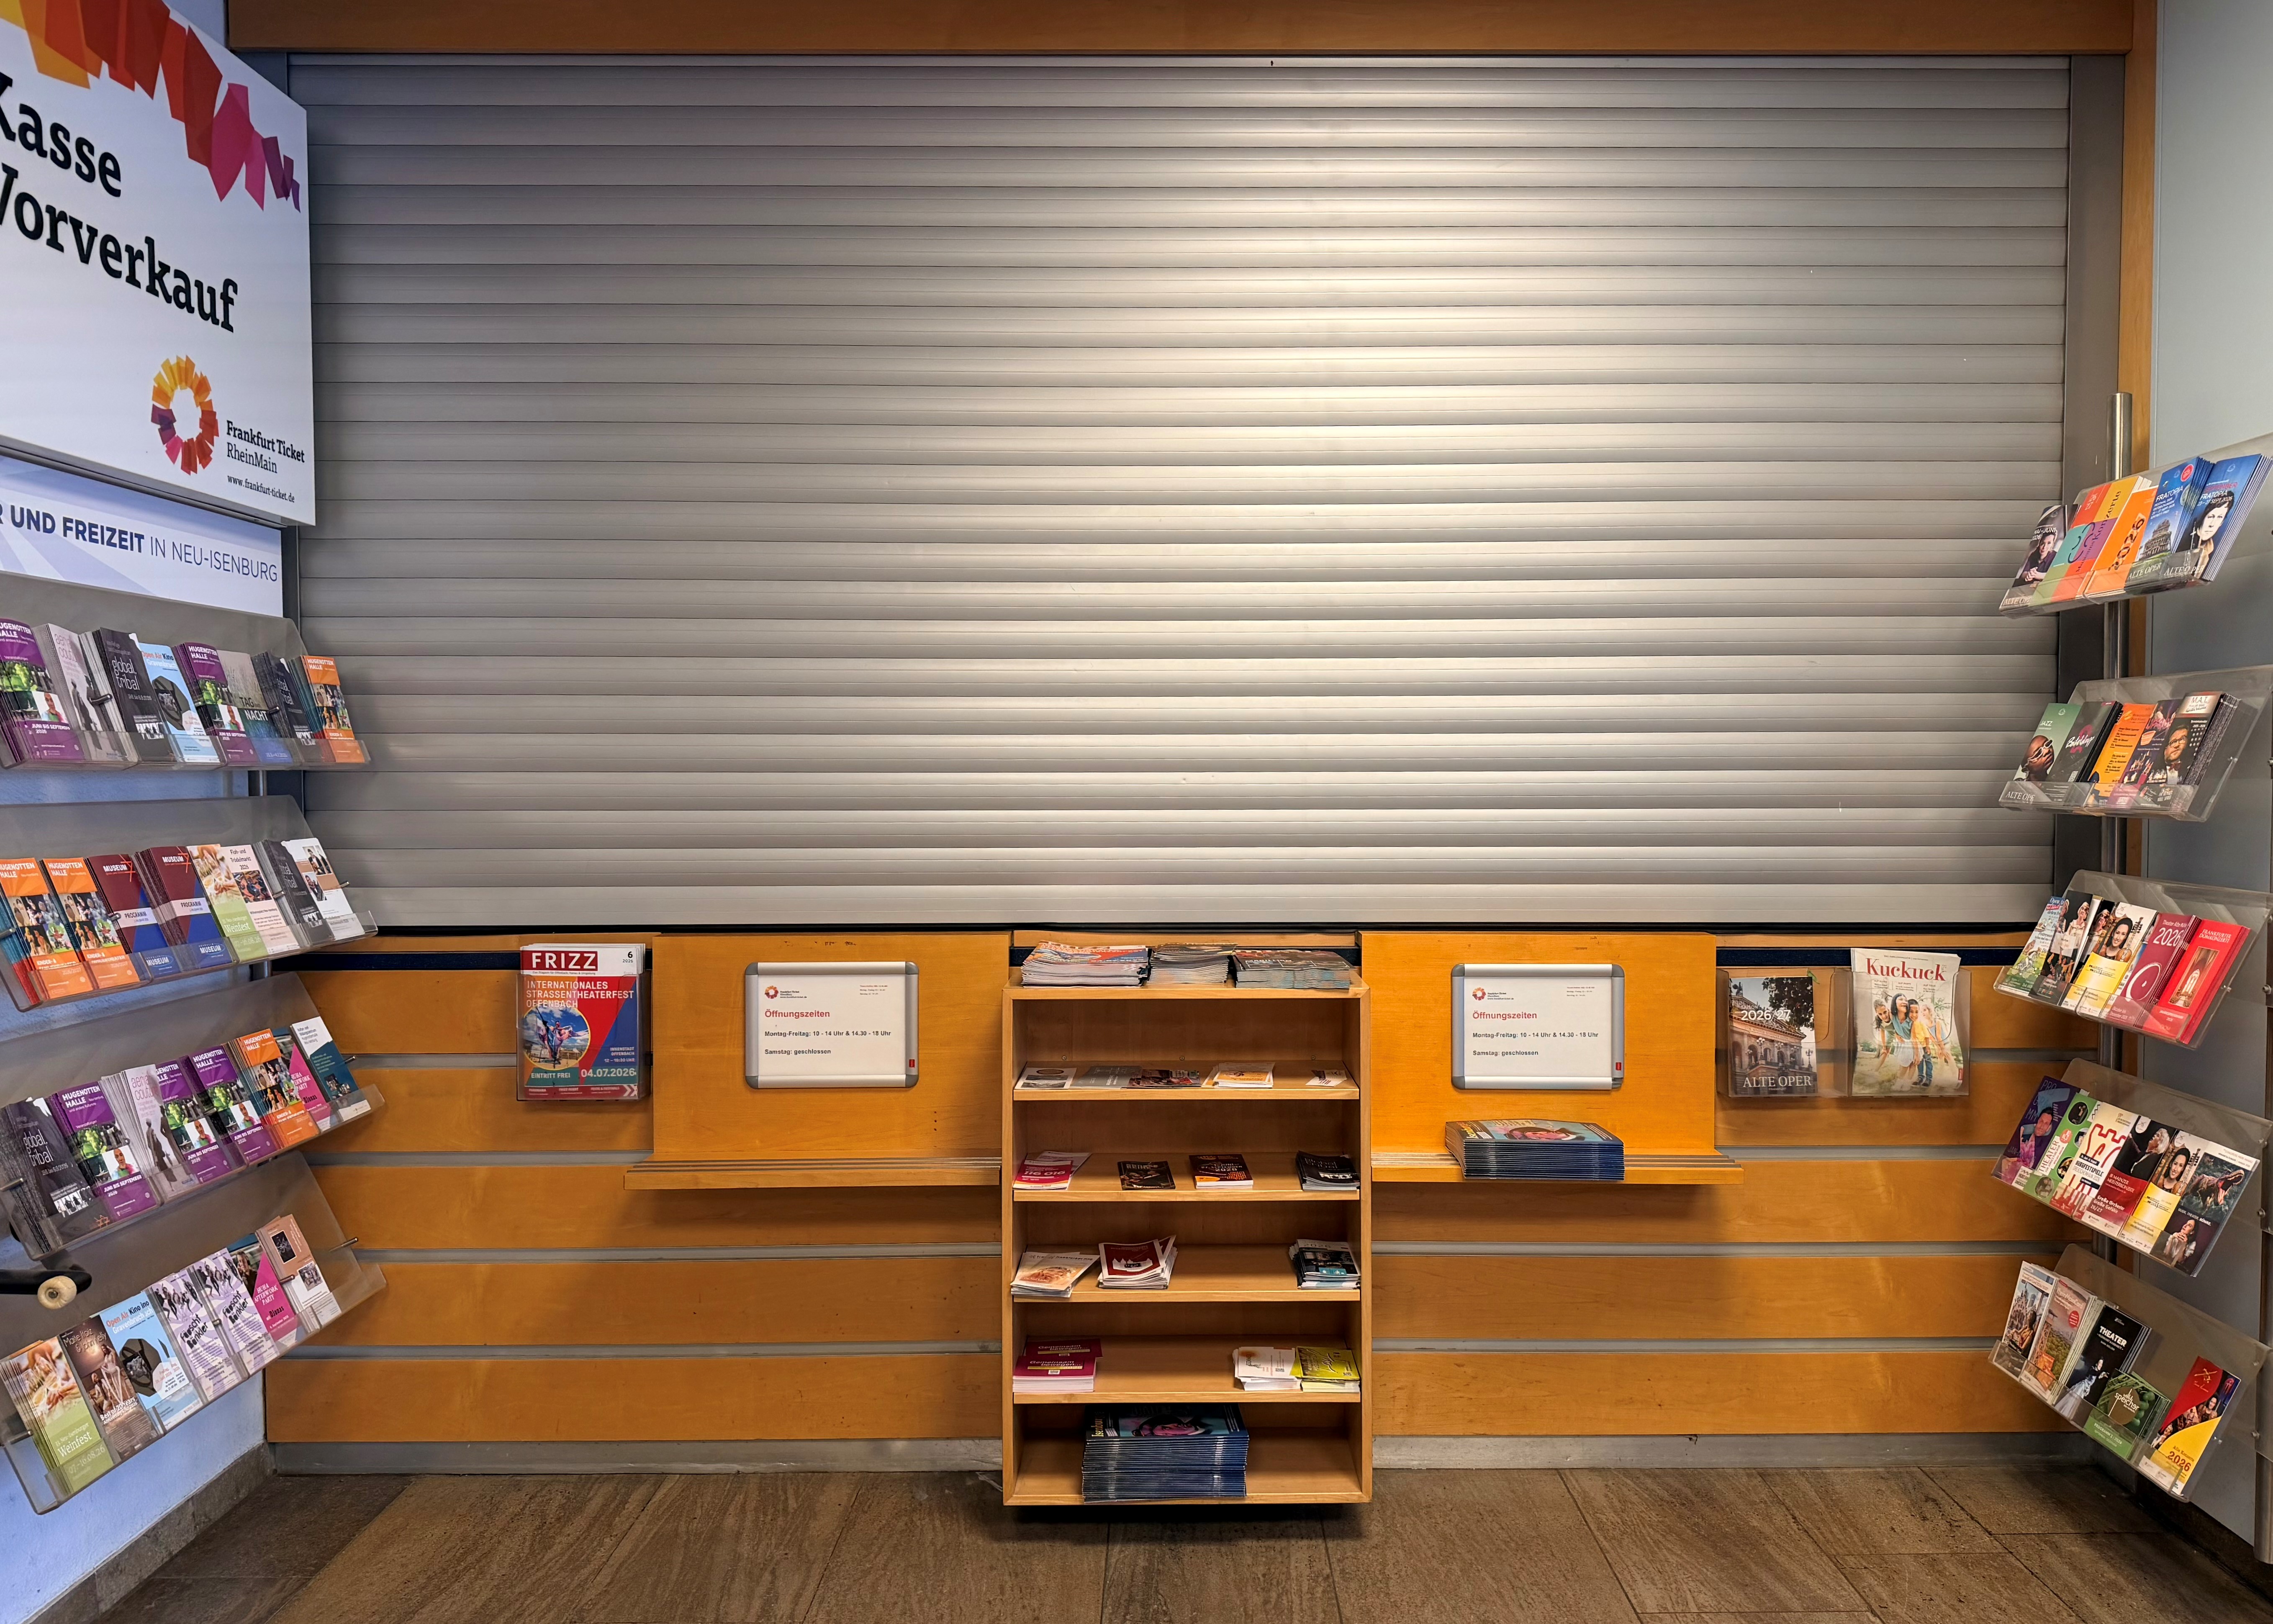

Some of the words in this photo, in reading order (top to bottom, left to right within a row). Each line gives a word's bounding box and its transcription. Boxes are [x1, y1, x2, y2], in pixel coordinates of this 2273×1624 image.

[226, 420, 275, 452] Frankfurt
[276, 439, 305, 463] Ticket
[227, 442, 277, 474] RheinMain
[227, 475, 295, 503] www.frankfurt-ticket.de
[2155, 485, 2183, 502] FRATOPIA
[2200, 489, 2228, 499] FRATOPIA
[10, 505, 56, 534] UND
[63, 517, 145, 553] FREIZEIT
[150, 536, 166, 558] IN
[172, 545, 278, 582] NEU-ISENBURG
[2128, 569, 2144, 580] ALTE
[2145, 562, 2162, 573] OPER
[0, 622, 32, 635] UGENOTTEN
[188, 646, 217, 656] HUGENOTTEN
[116, 674, 140, 690] tribal
[239, 697, 255, 708] TAG
[244, 710, 268, 721] NACHT
[2006, 791, 2022, 800] ALTE
[103, 864, 128, 872] MUSEUM
[224, 922, 250, 933] Weinfest
[2153, 927, 2183, 947] 2026
[199, 945, 222, 954] MUSEUM
[146, 957, 170, 966] MUSEUM
[532, 952, 596, 969] FRIZZ
[1866, 958, 1947, 982] Kuckuck
[527, 980, 608, 990] INTERNATIONALES
[526, 990, 634, 999] STRASSENTHEATERFEST
[526, 1000, 578, 1008] OFFENBACH
[765, 1009, 830, 1019] Öffnungszeiten
[1472, 1010, 1537, 1021] Öffnungszeiten
[1741, 1008, 1791, 1022] 2026/27
[243, 1032, 271, 1045] HUGENOTTEN
[246, 1042, 260, 1051] HALLE
[193, 1049, 223, 1062] HUGENOTTEN
[196, 1058, 214, 1068] HALLE
[581, 1068, 636, 1078] 04.07.2026
[1743, 1076, 1776, 1088] ALTE
[1778, 1075, 1812, 1086] OPER
[62, 1085, 100, 1101] HUGENOTTEN
[65, 1097, 86, 1108] HALLE
[28, 1145, 54, 1167] tribal
[2038, 1140, 2059, 1172] THEATER
[2097, 1195, 2109, 1203] Große
[254, 1284, 278, 1303] AFTERWORK
[262, 1294, 275, 1306] PARTY
[106, 1316, 121, 1327] Open
[128, 1305, 141, 1315] Kino
[228, 1298, 248, 1324] Bänkler
[187, 1321, 208, 1349] Bänkler
[2100, 1325, 2127, 1347] THEATER
[2114, 1392, 2140, 1411] speicher
[100, 1408, 113, 1421] Best
[58, 1431, 92, 1457] Weinfest
[2168, 1451, 2191, 1472] 2026
